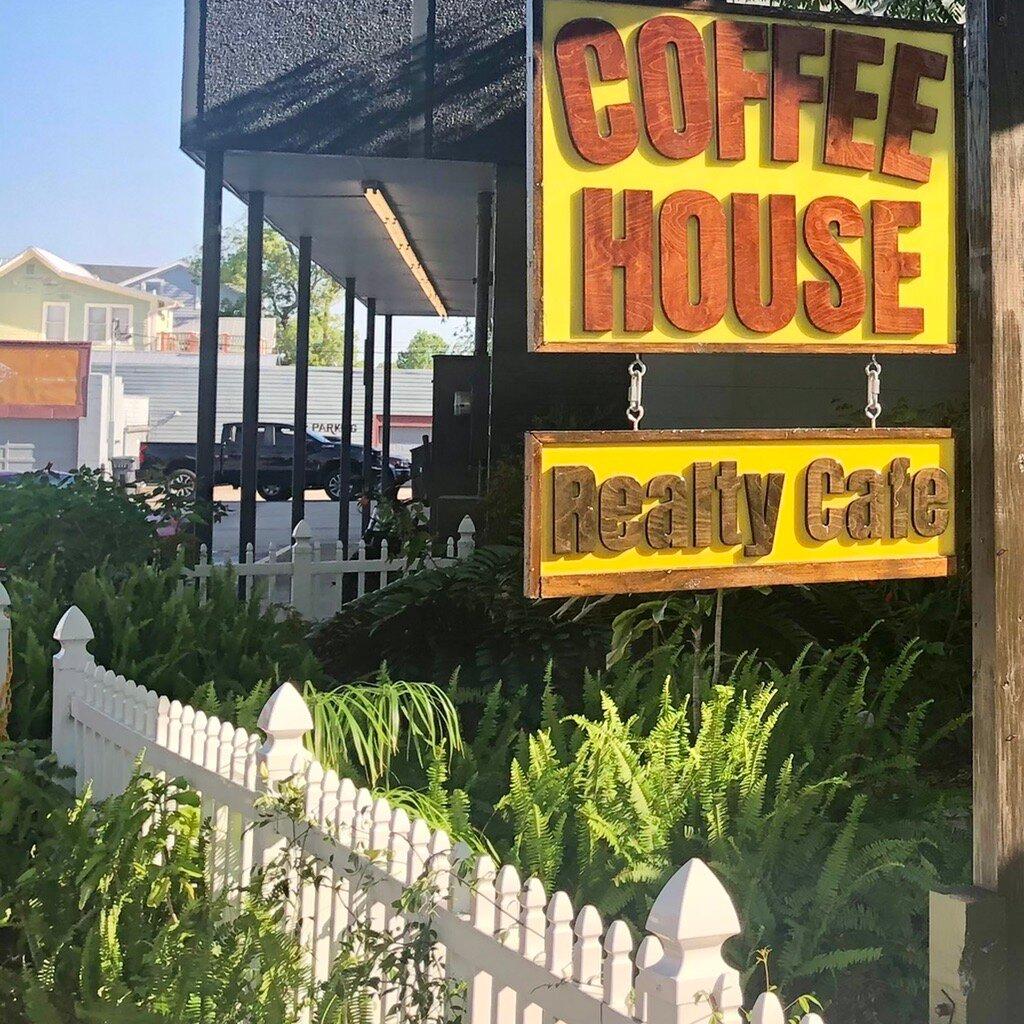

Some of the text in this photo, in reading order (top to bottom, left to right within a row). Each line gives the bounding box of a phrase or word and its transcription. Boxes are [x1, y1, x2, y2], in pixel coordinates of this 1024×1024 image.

[554, 15, 948, 183] COFFEE
[582, 187, 924, 334] HOUSE
[312, 422, 357, 435] PARKG
[552, 458, 949, 557] Realty Cafe
